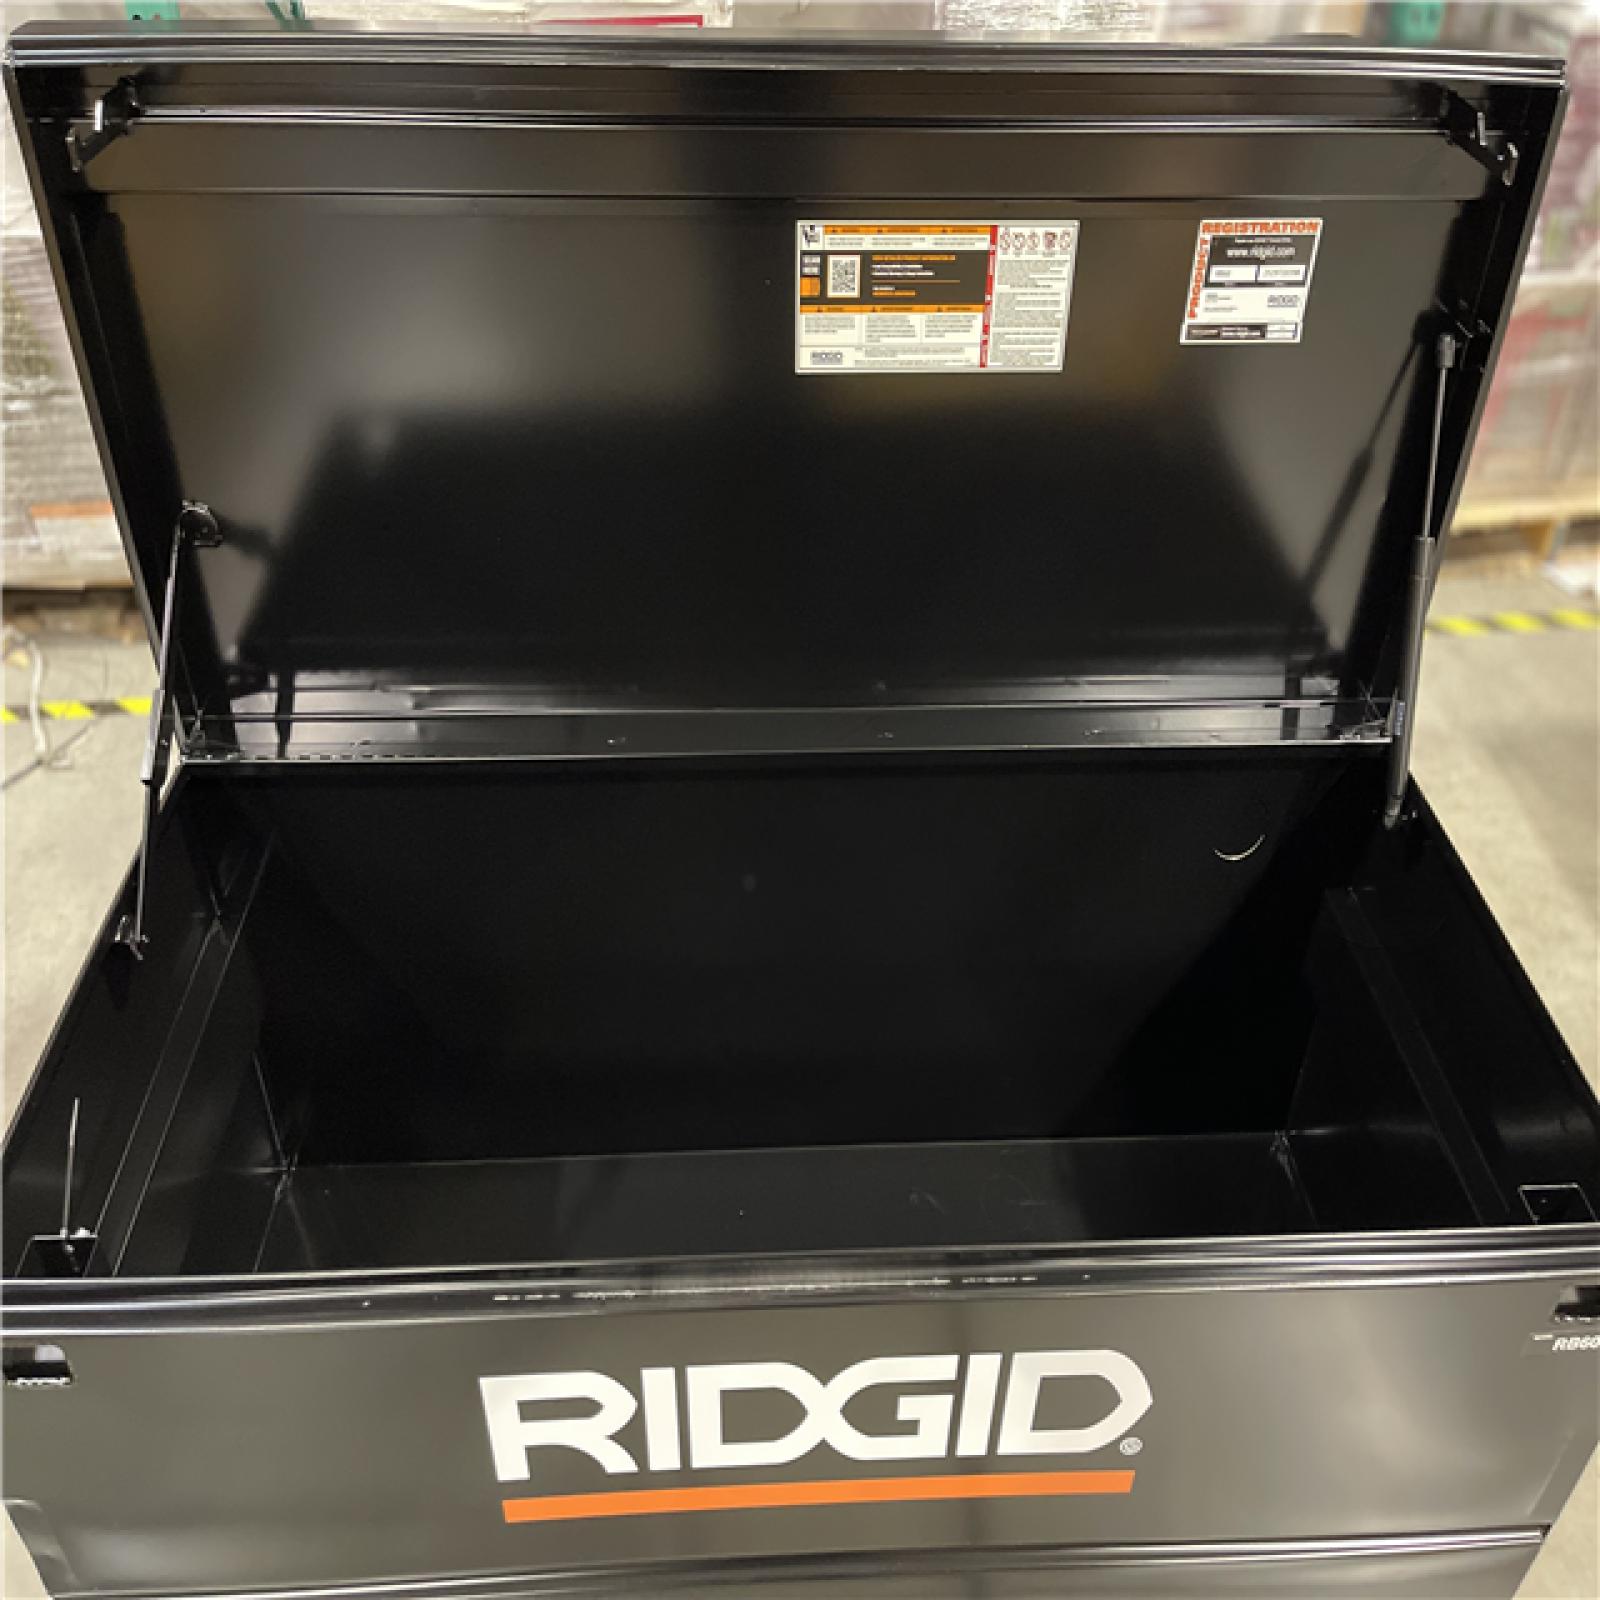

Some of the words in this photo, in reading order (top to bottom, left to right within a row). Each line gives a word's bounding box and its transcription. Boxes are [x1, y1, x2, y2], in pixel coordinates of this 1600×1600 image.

[1202, 221, 1318, 234] REGISTRATION
[1187, 237, 1209, 318] PRODUCT
[479, 1348, 1154, 1482] RIDGID
